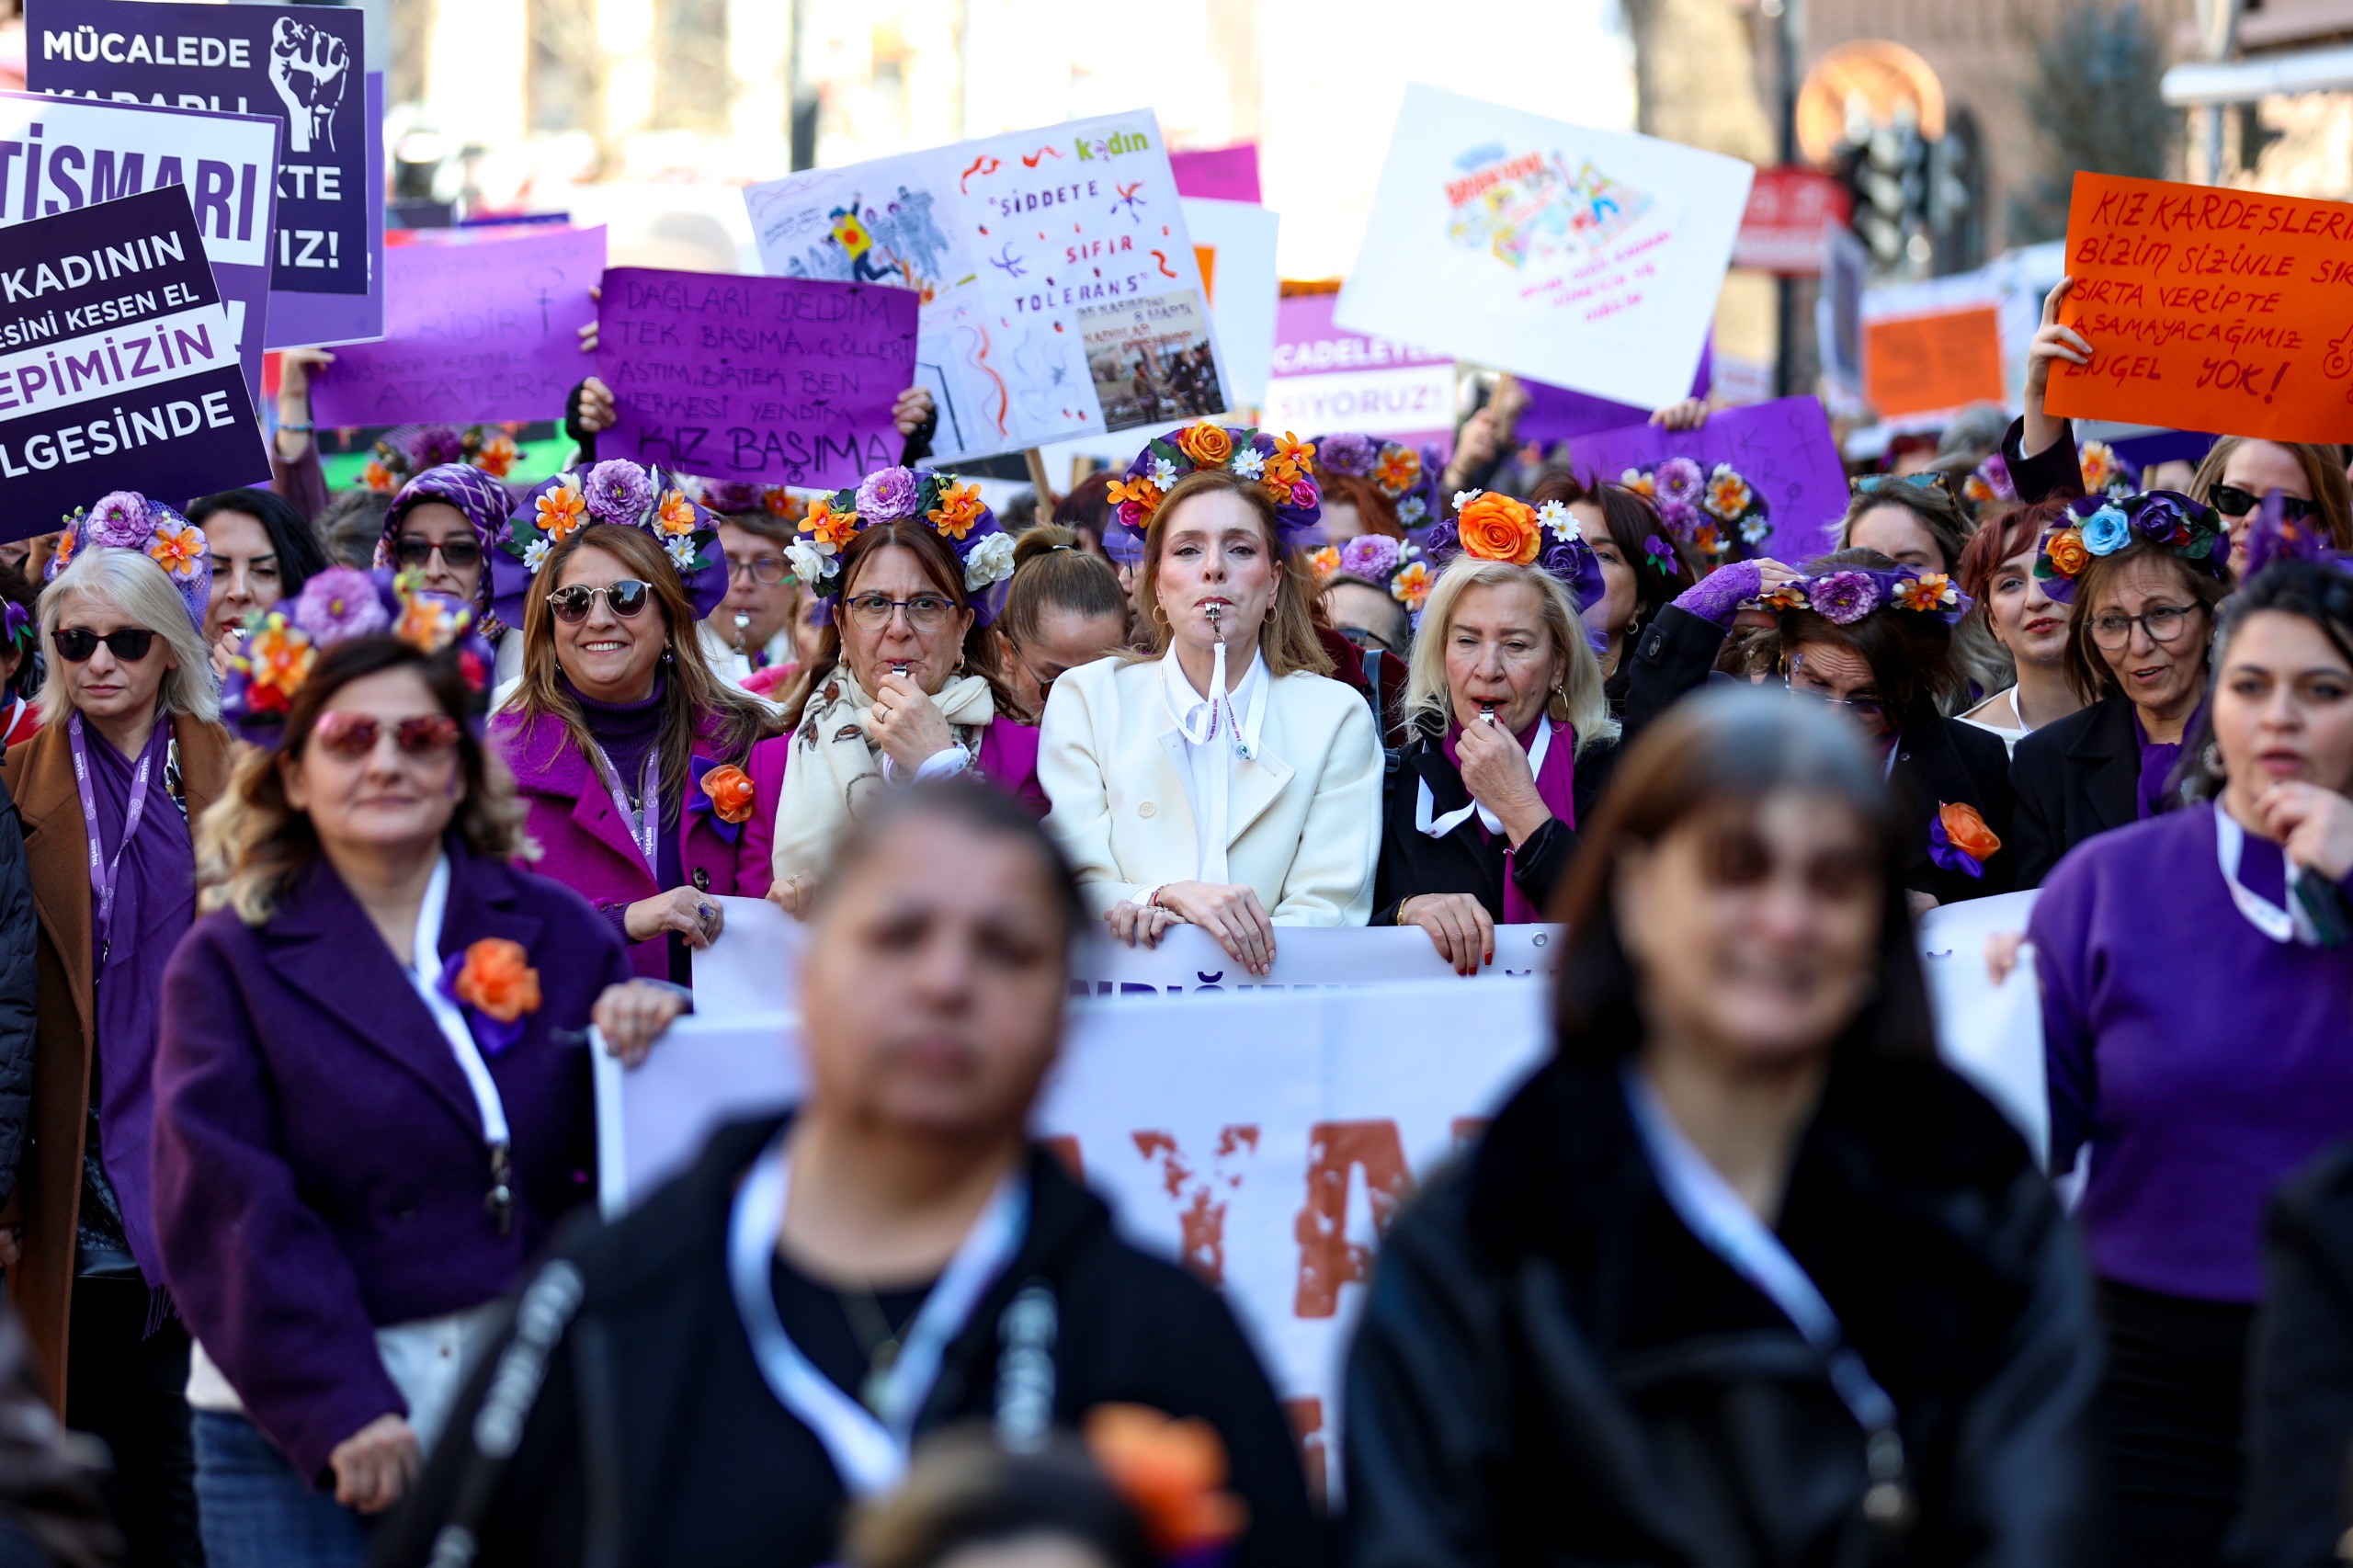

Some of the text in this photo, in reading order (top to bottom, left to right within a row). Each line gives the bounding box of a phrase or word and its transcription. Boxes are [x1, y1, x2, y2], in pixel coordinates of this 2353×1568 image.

[43, 26, 251, 68] MÜCALEDE
[2090, 189, 2353, 241] KIZ KARDEŞLERI
[3, 231, 187, 303] KADININ
[2075, 233, 2172, 278] BİZİM
[2177, 243, 2295, 277] SİZİNLE
[64, 290, 157, 332] KESEN
[163, 282, 199, 307] EL
[625, 279, 892, 329] DAĞLARI DELDİM
[2070, 278, 2281, 313] SIRTA VERİPTE
[615, 321, 680, 347] TEK
[797, 369, 862, 397] BEN
[2064, 355, 2162, 388] ENGEL
[374, 371, 568, 411] ATATÜRK
[748, 398, 858, 427] YENDİM
[636, 426, 893, 480] KIZ BAŞIMA
[75, 751, 85, 781] YAŞASIN
[140, 756, 149, 782] YAŞASIN
[90, 837, 100, 868] YAŞASIN
[645, 826, 654, 857] YAŞASIN
